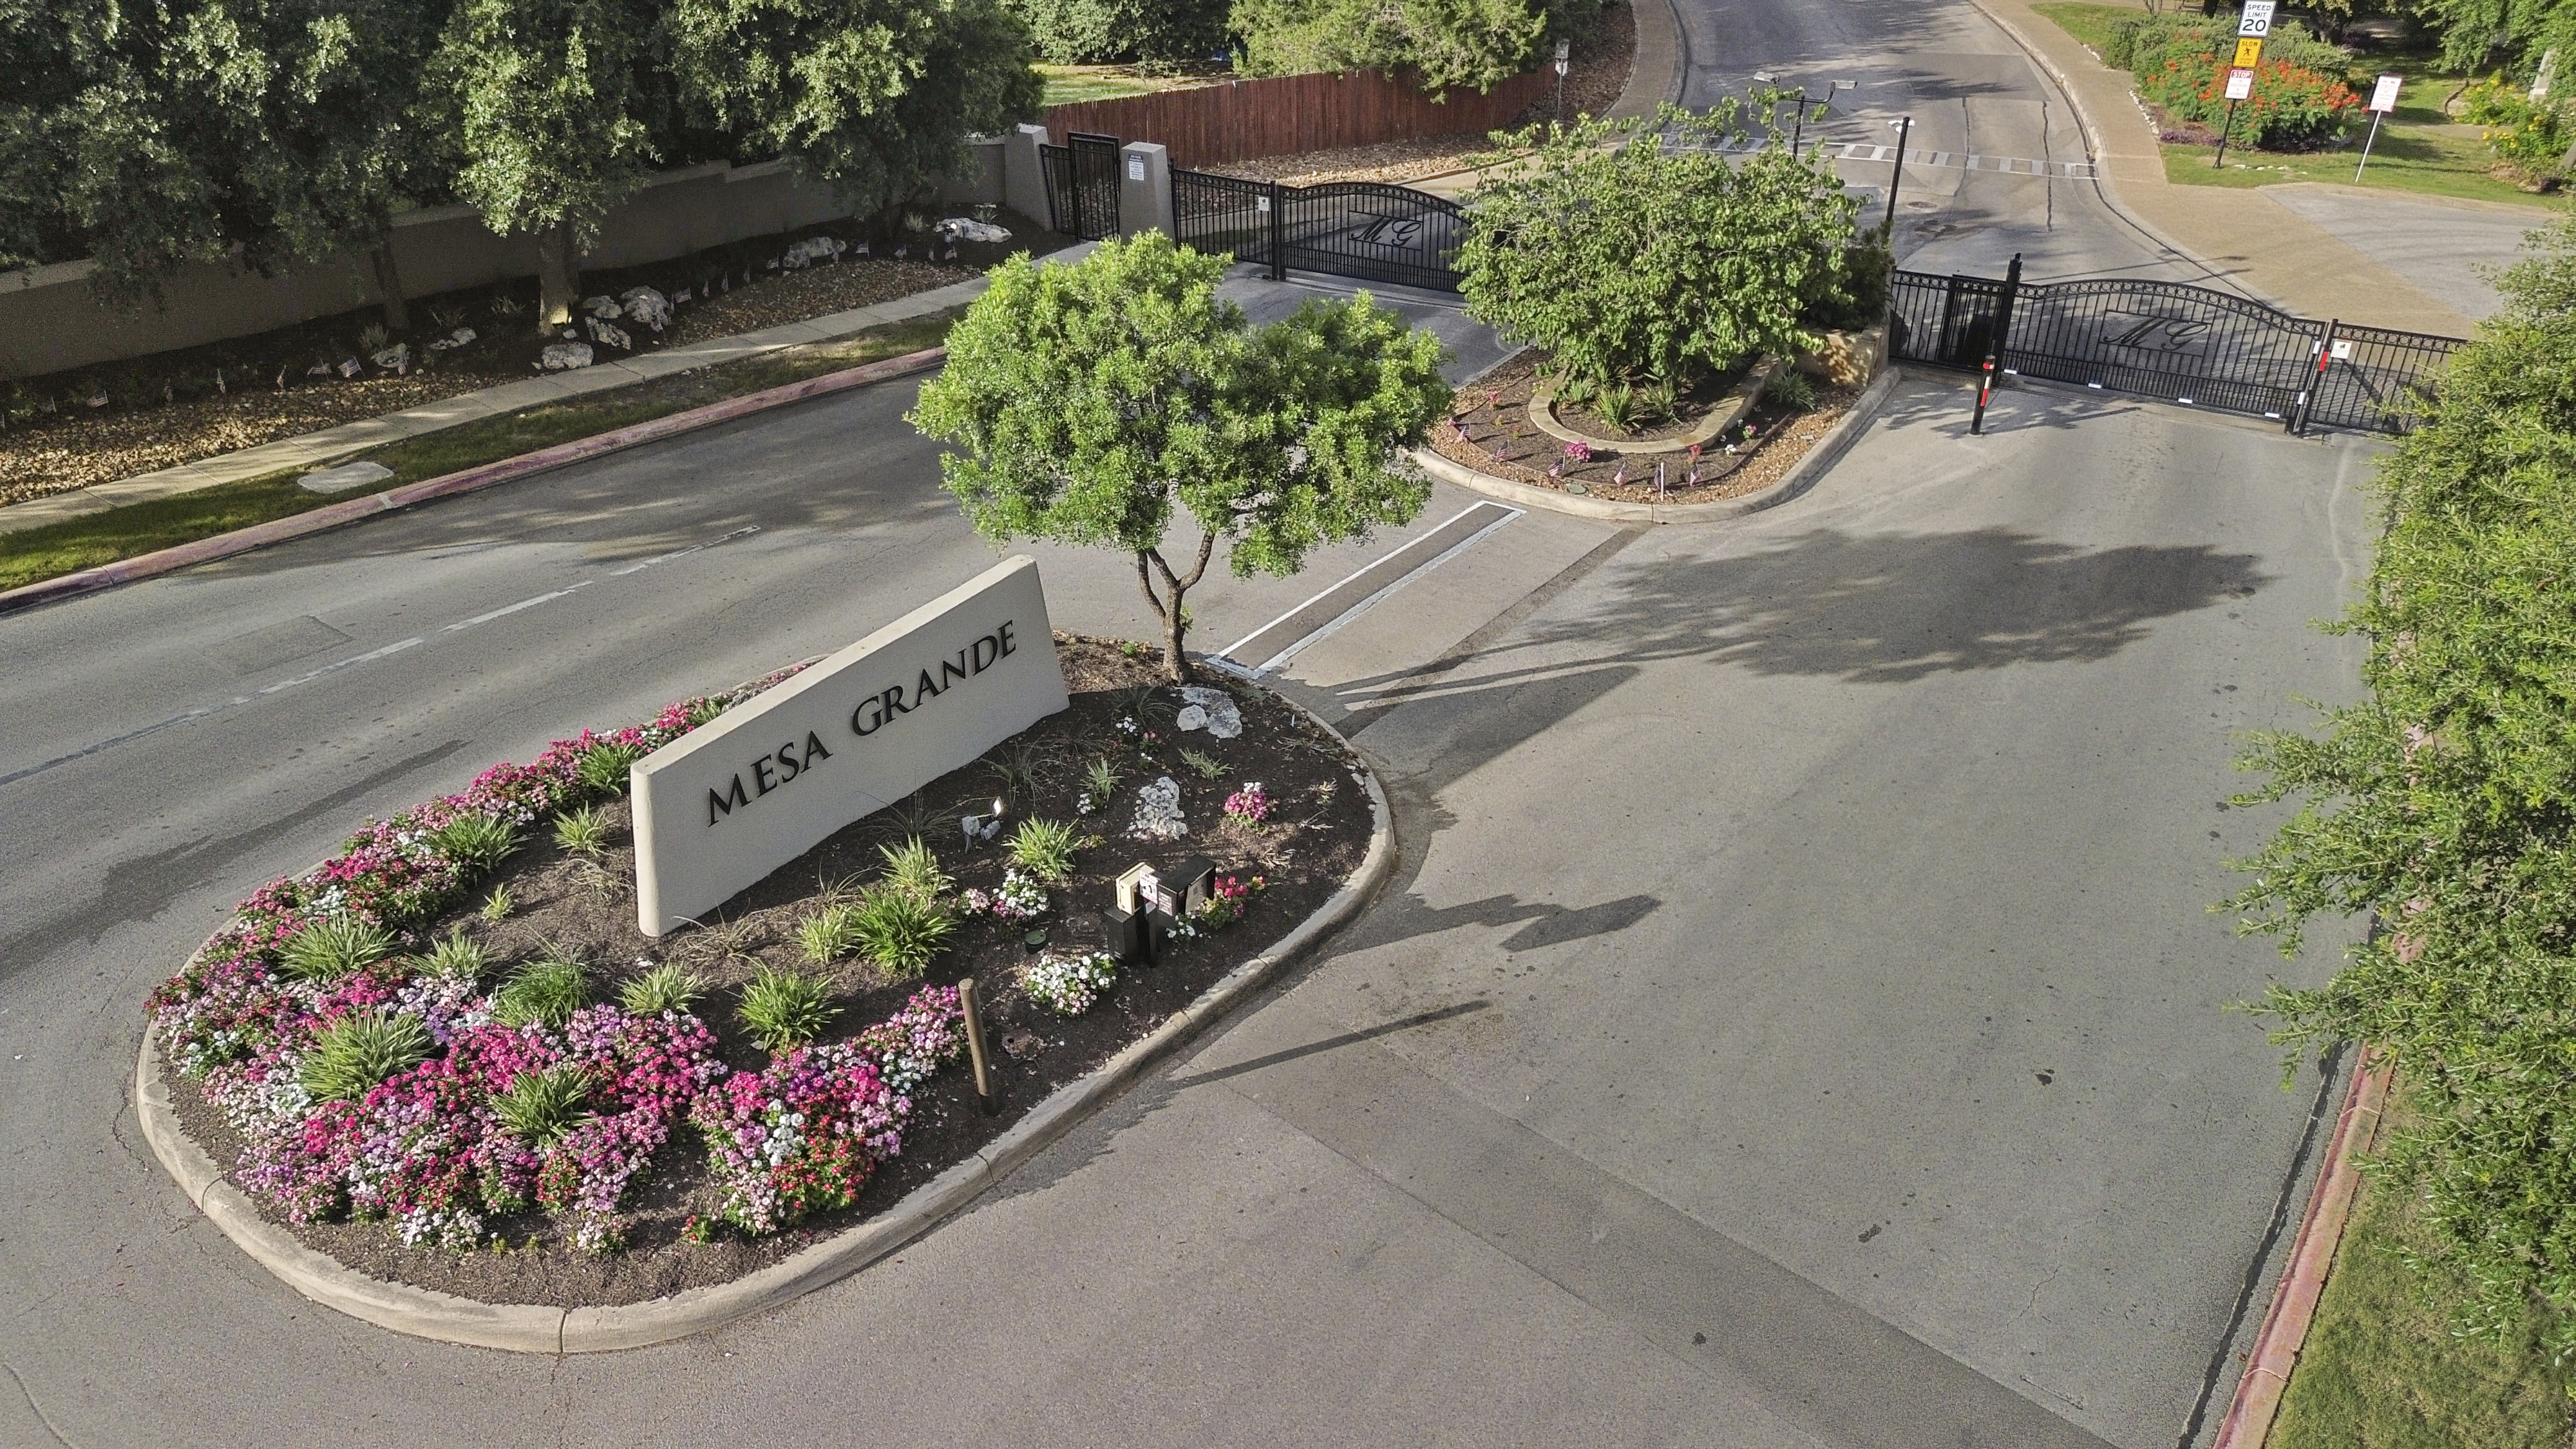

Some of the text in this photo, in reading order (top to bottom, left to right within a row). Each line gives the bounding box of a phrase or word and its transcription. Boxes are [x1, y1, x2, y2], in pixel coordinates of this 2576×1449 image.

[2242, 19, 2266, 32] 20
[708, 620, 1016, 828] MESA GRANDE
